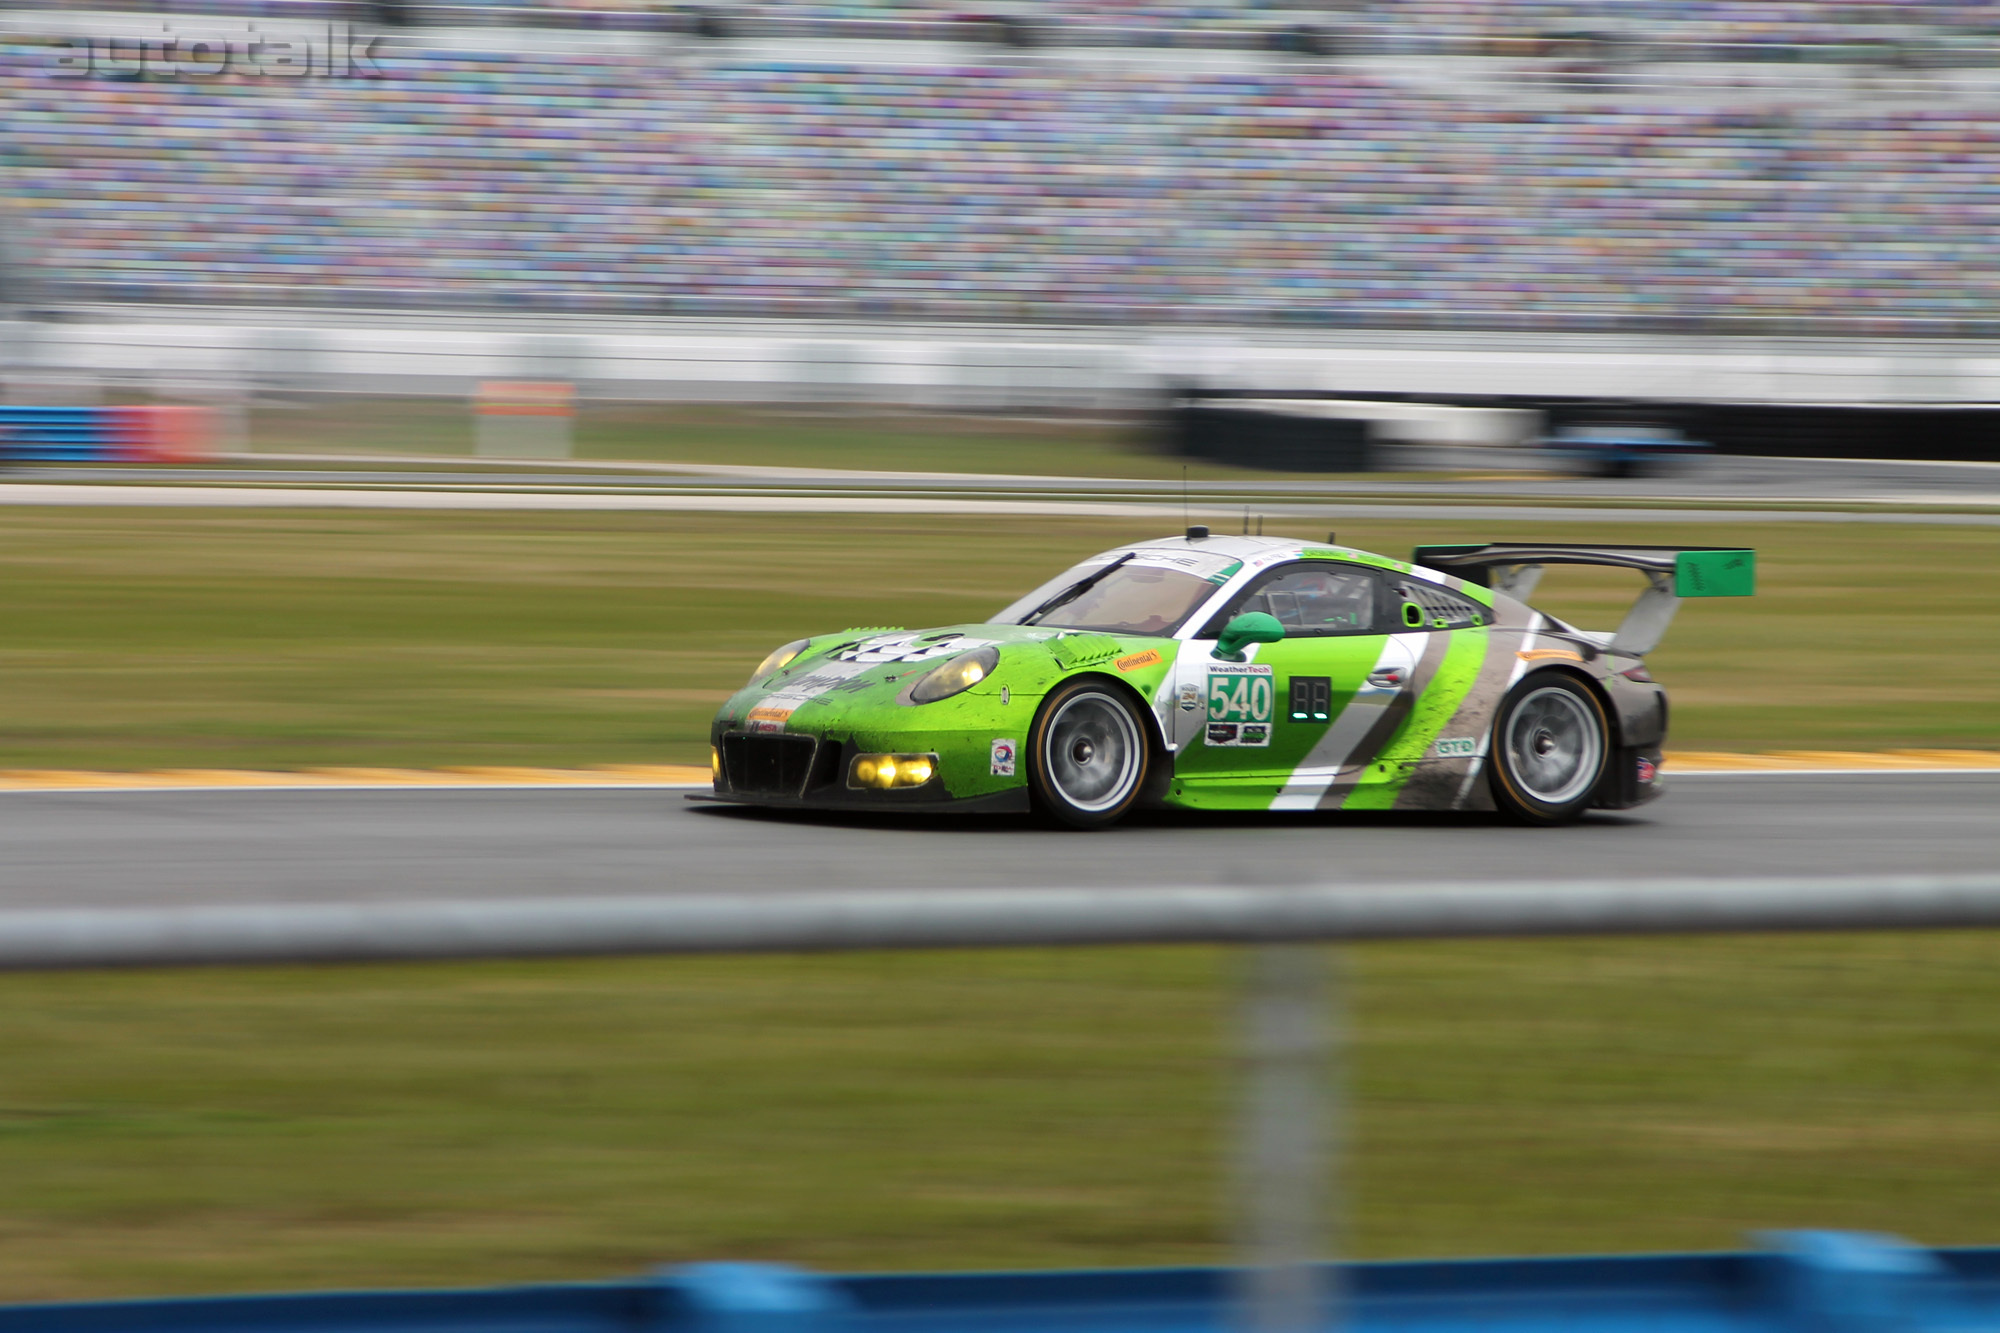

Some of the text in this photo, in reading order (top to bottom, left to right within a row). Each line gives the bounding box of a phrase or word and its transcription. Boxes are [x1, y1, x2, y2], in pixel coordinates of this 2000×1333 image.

[1116, 651, 1153, 671] Continental
[1210, 676, 1271, 721] 540
[1438, 740, 1473, 753] GTD
